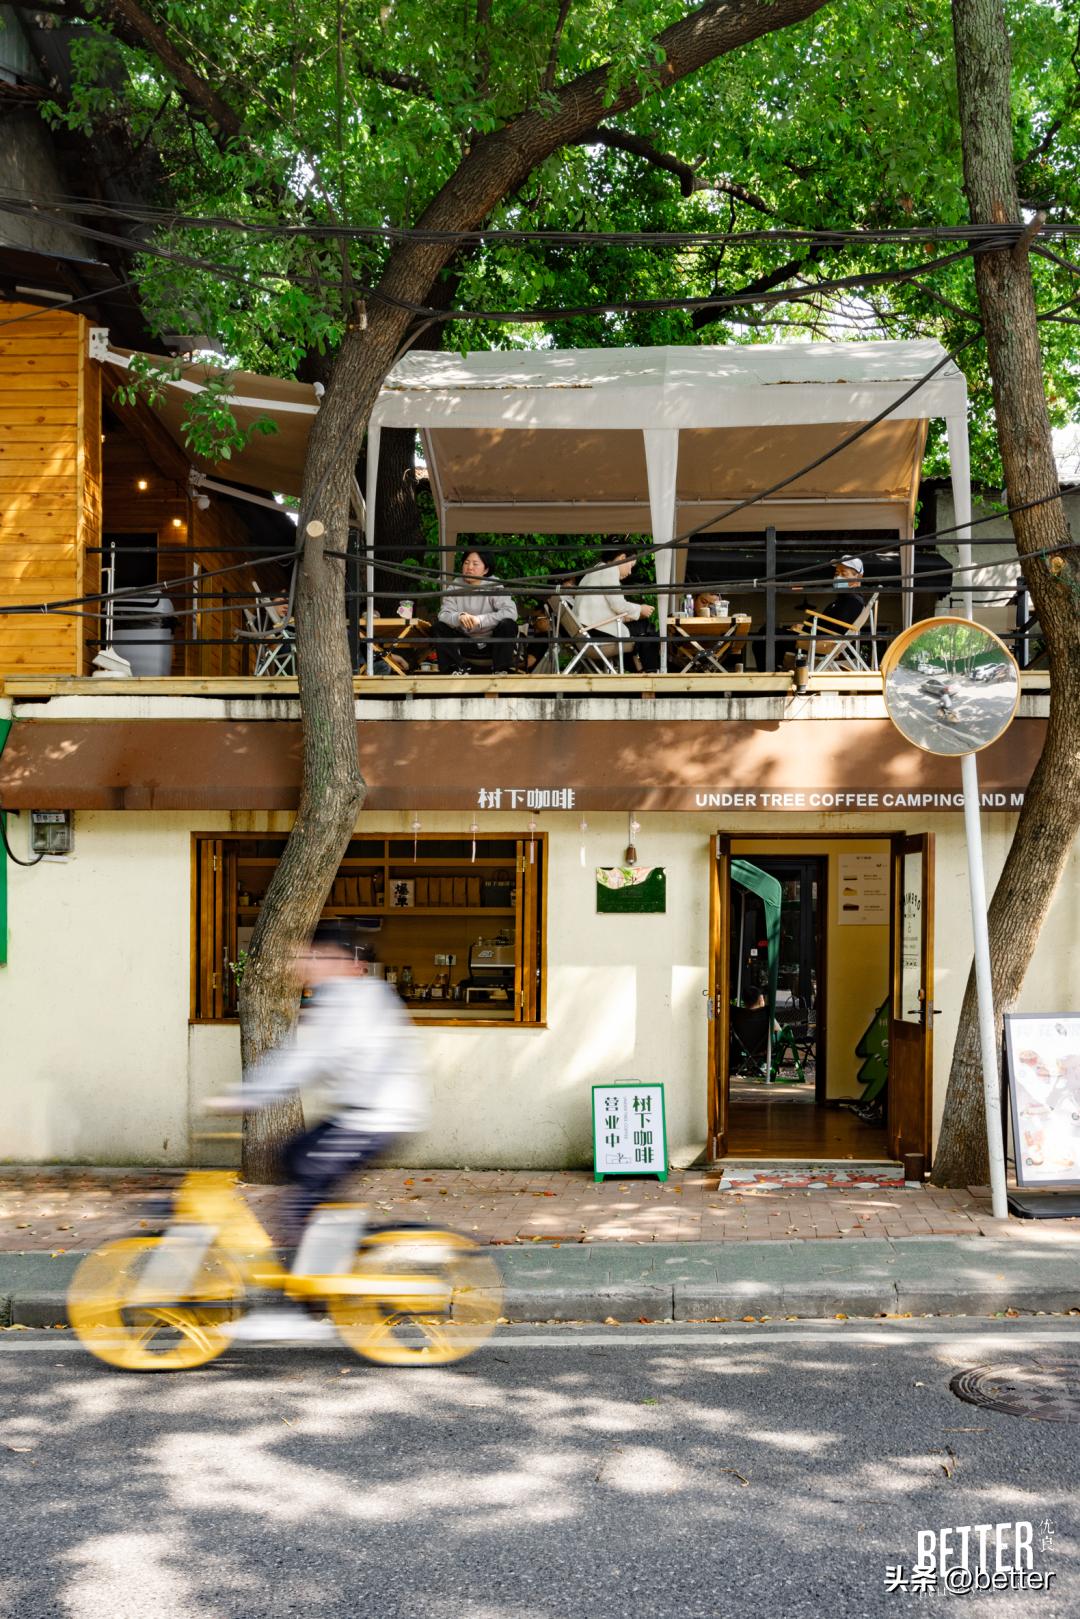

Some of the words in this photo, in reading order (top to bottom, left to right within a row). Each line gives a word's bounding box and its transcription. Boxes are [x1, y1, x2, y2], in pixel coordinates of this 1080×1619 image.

[477, 787, 576, 809] 树下咖啡
[695, 793, 757, 807] UNDER
[759, 793, 806, 807] TREE
[809, 793, 879, 807] COFFEE
[882, 793, 965, 807] CAMPING
[974, 793, 1006, 807] ND
[604, 1096, 620, 1148] 营业中
[632, 1095, 655, 1164] 树下咖啡
